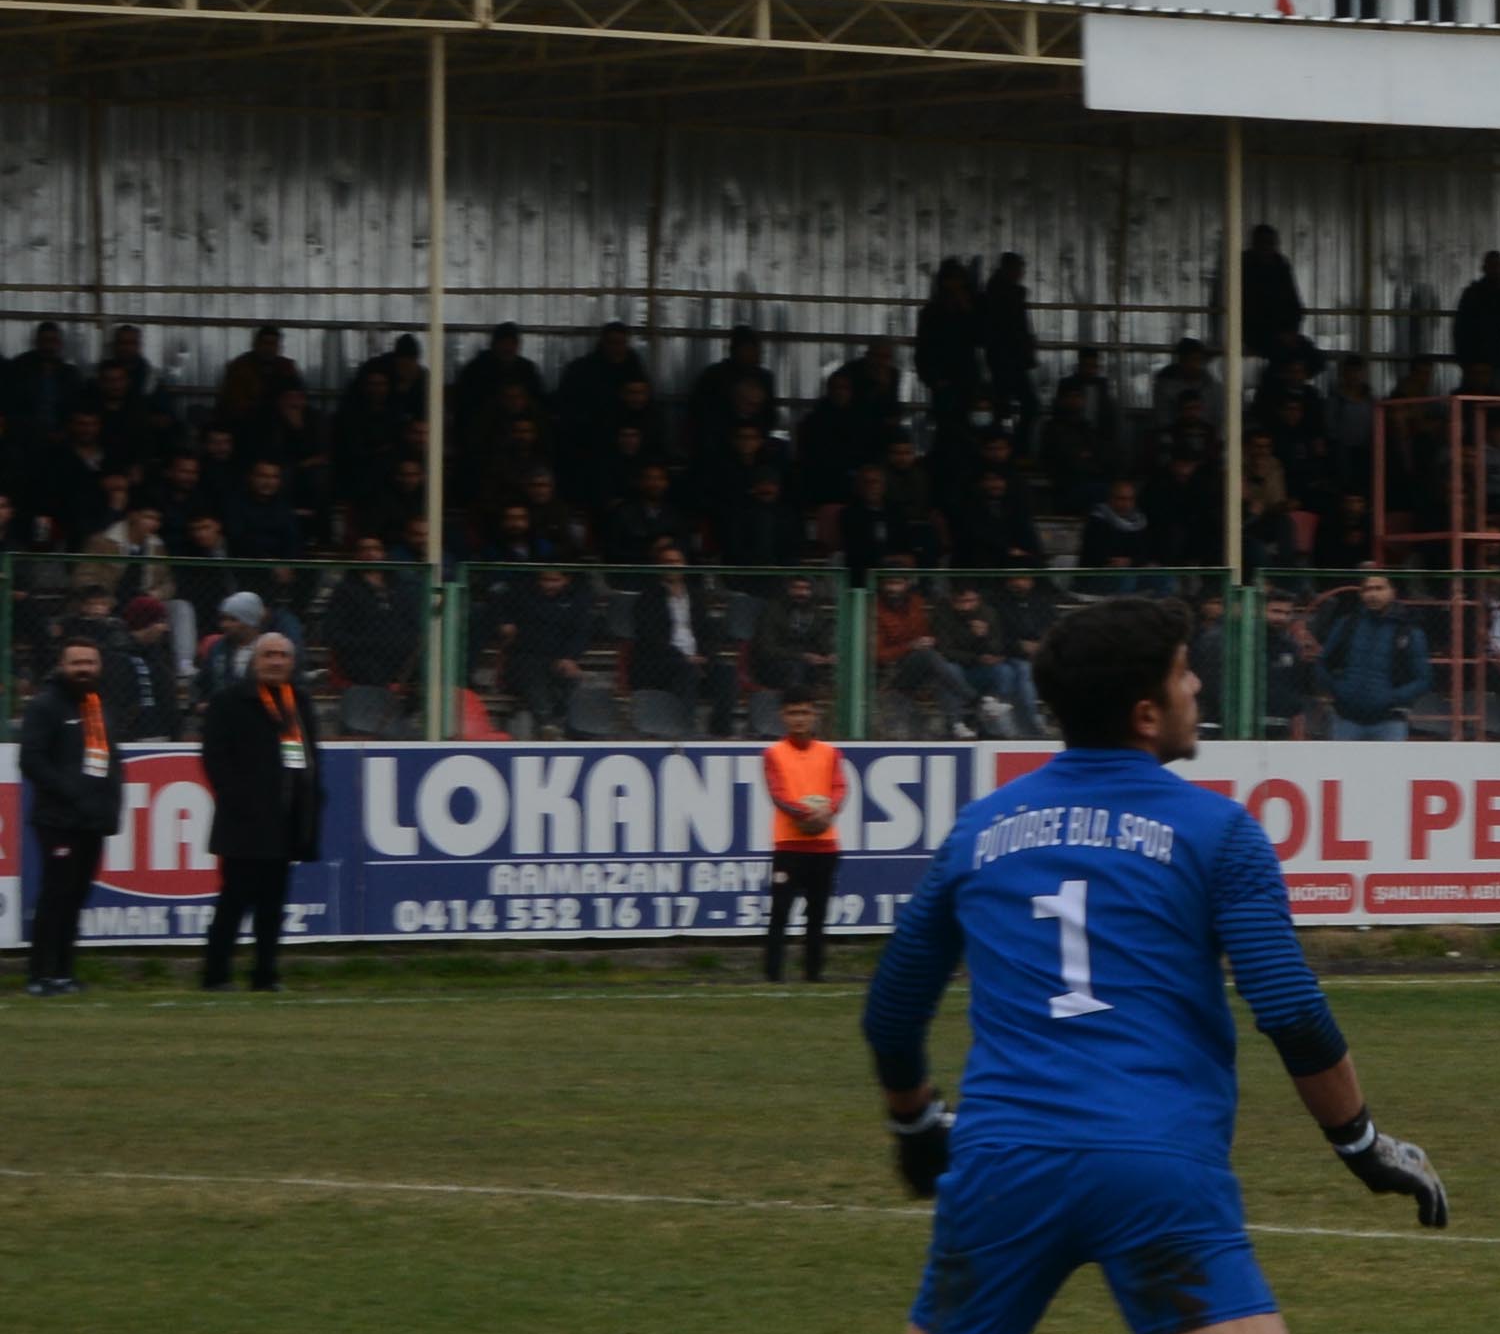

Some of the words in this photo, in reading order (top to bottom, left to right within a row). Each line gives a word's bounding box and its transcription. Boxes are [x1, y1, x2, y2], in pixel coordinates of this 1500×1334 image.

[362, 754, 957, 857] LOKANTSI
[1117, 812, 1174, 865] SPOR
[488, 863, 682, 895] RAMAZAN
[688, 862, 774, 892] BAY
[393, 899, 498, 932] 0414
[593, 897, 642, 929] 16
[653, 896, 700, 928] 17
[1031, 879, 1115, 1019] 1
